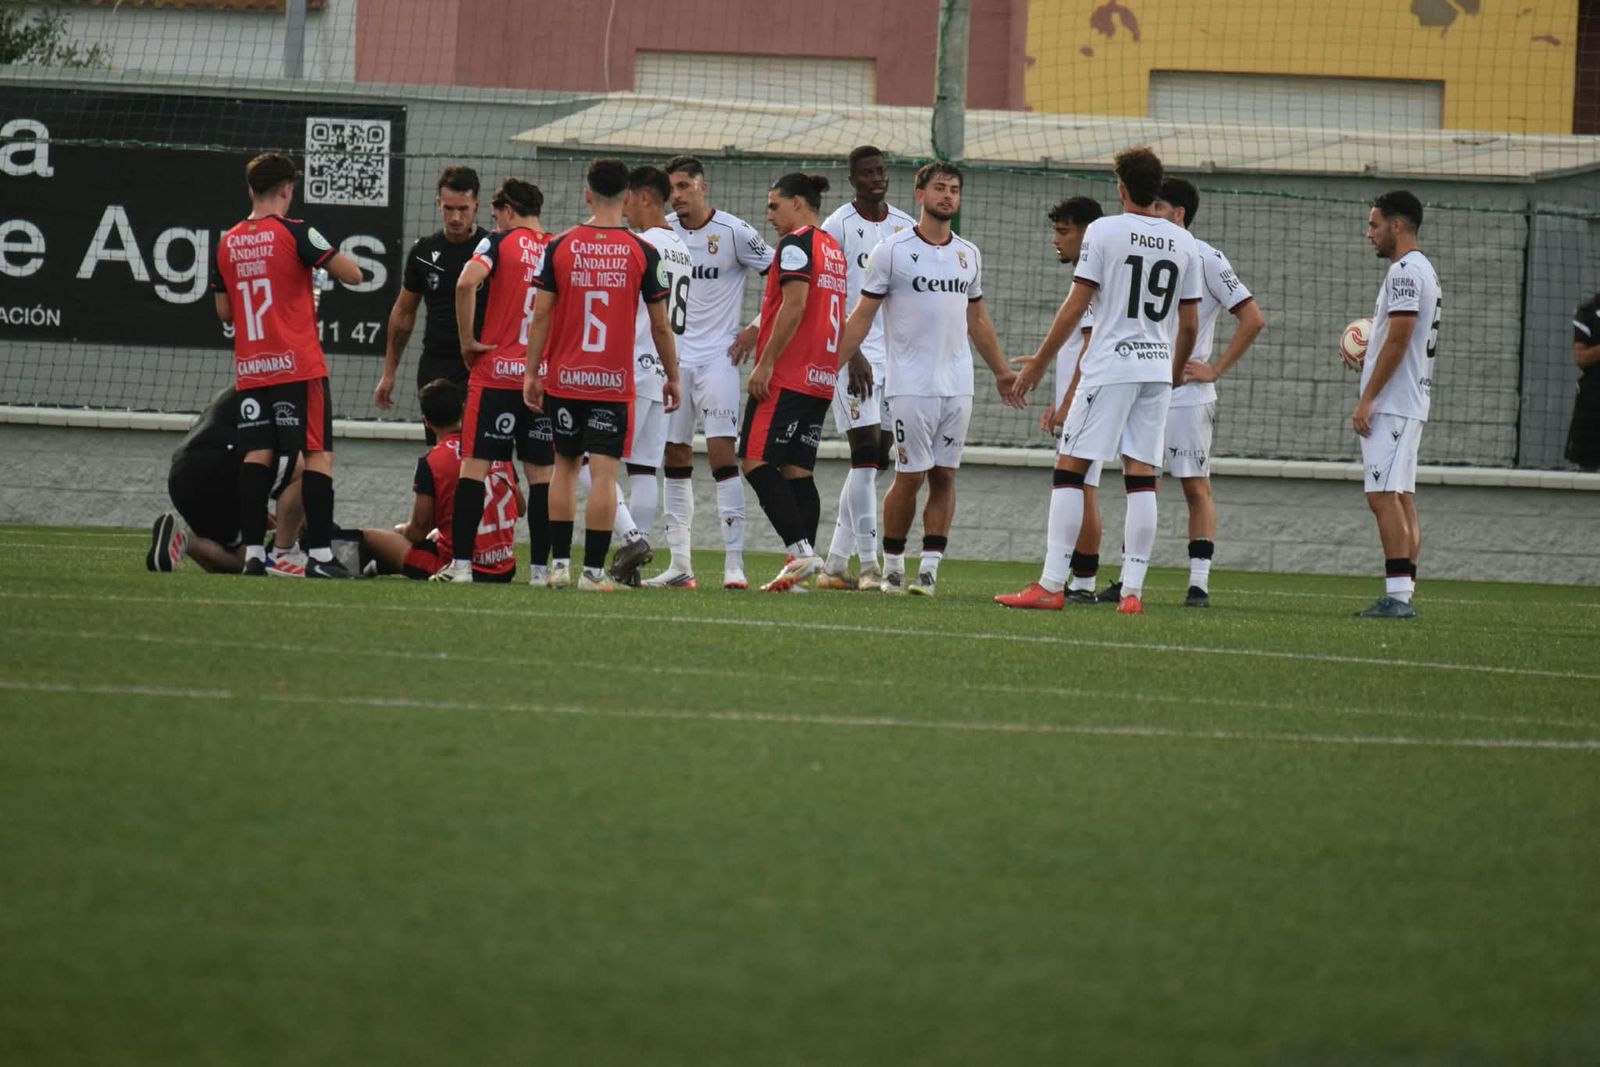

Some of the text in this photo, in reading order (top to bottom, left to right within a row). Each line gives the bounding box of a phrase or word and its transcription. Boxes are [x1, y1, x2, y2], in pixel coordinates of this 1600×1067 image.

[570, 239, 630, 256] CAPRICHO
[1130, 232, 1165, 251] PACO
[76, 204, 389, 305] Ags
[573, 253, 628, 270] ANDALUZ
[911, 275, 969, 295] Ceuta
[1124, 254, 1180, 323] 19
[236, 278, 273, 342] 17
[581, 290, 609, 353] 6
[826, 294, 840, 353] 9
[351, 322, 381, 344] 47
[238, 354, 293, 375] CAMPOARAS
[559, 370, 623, 388] CAMPOARAS
[895, 418, 906, 443] 6
